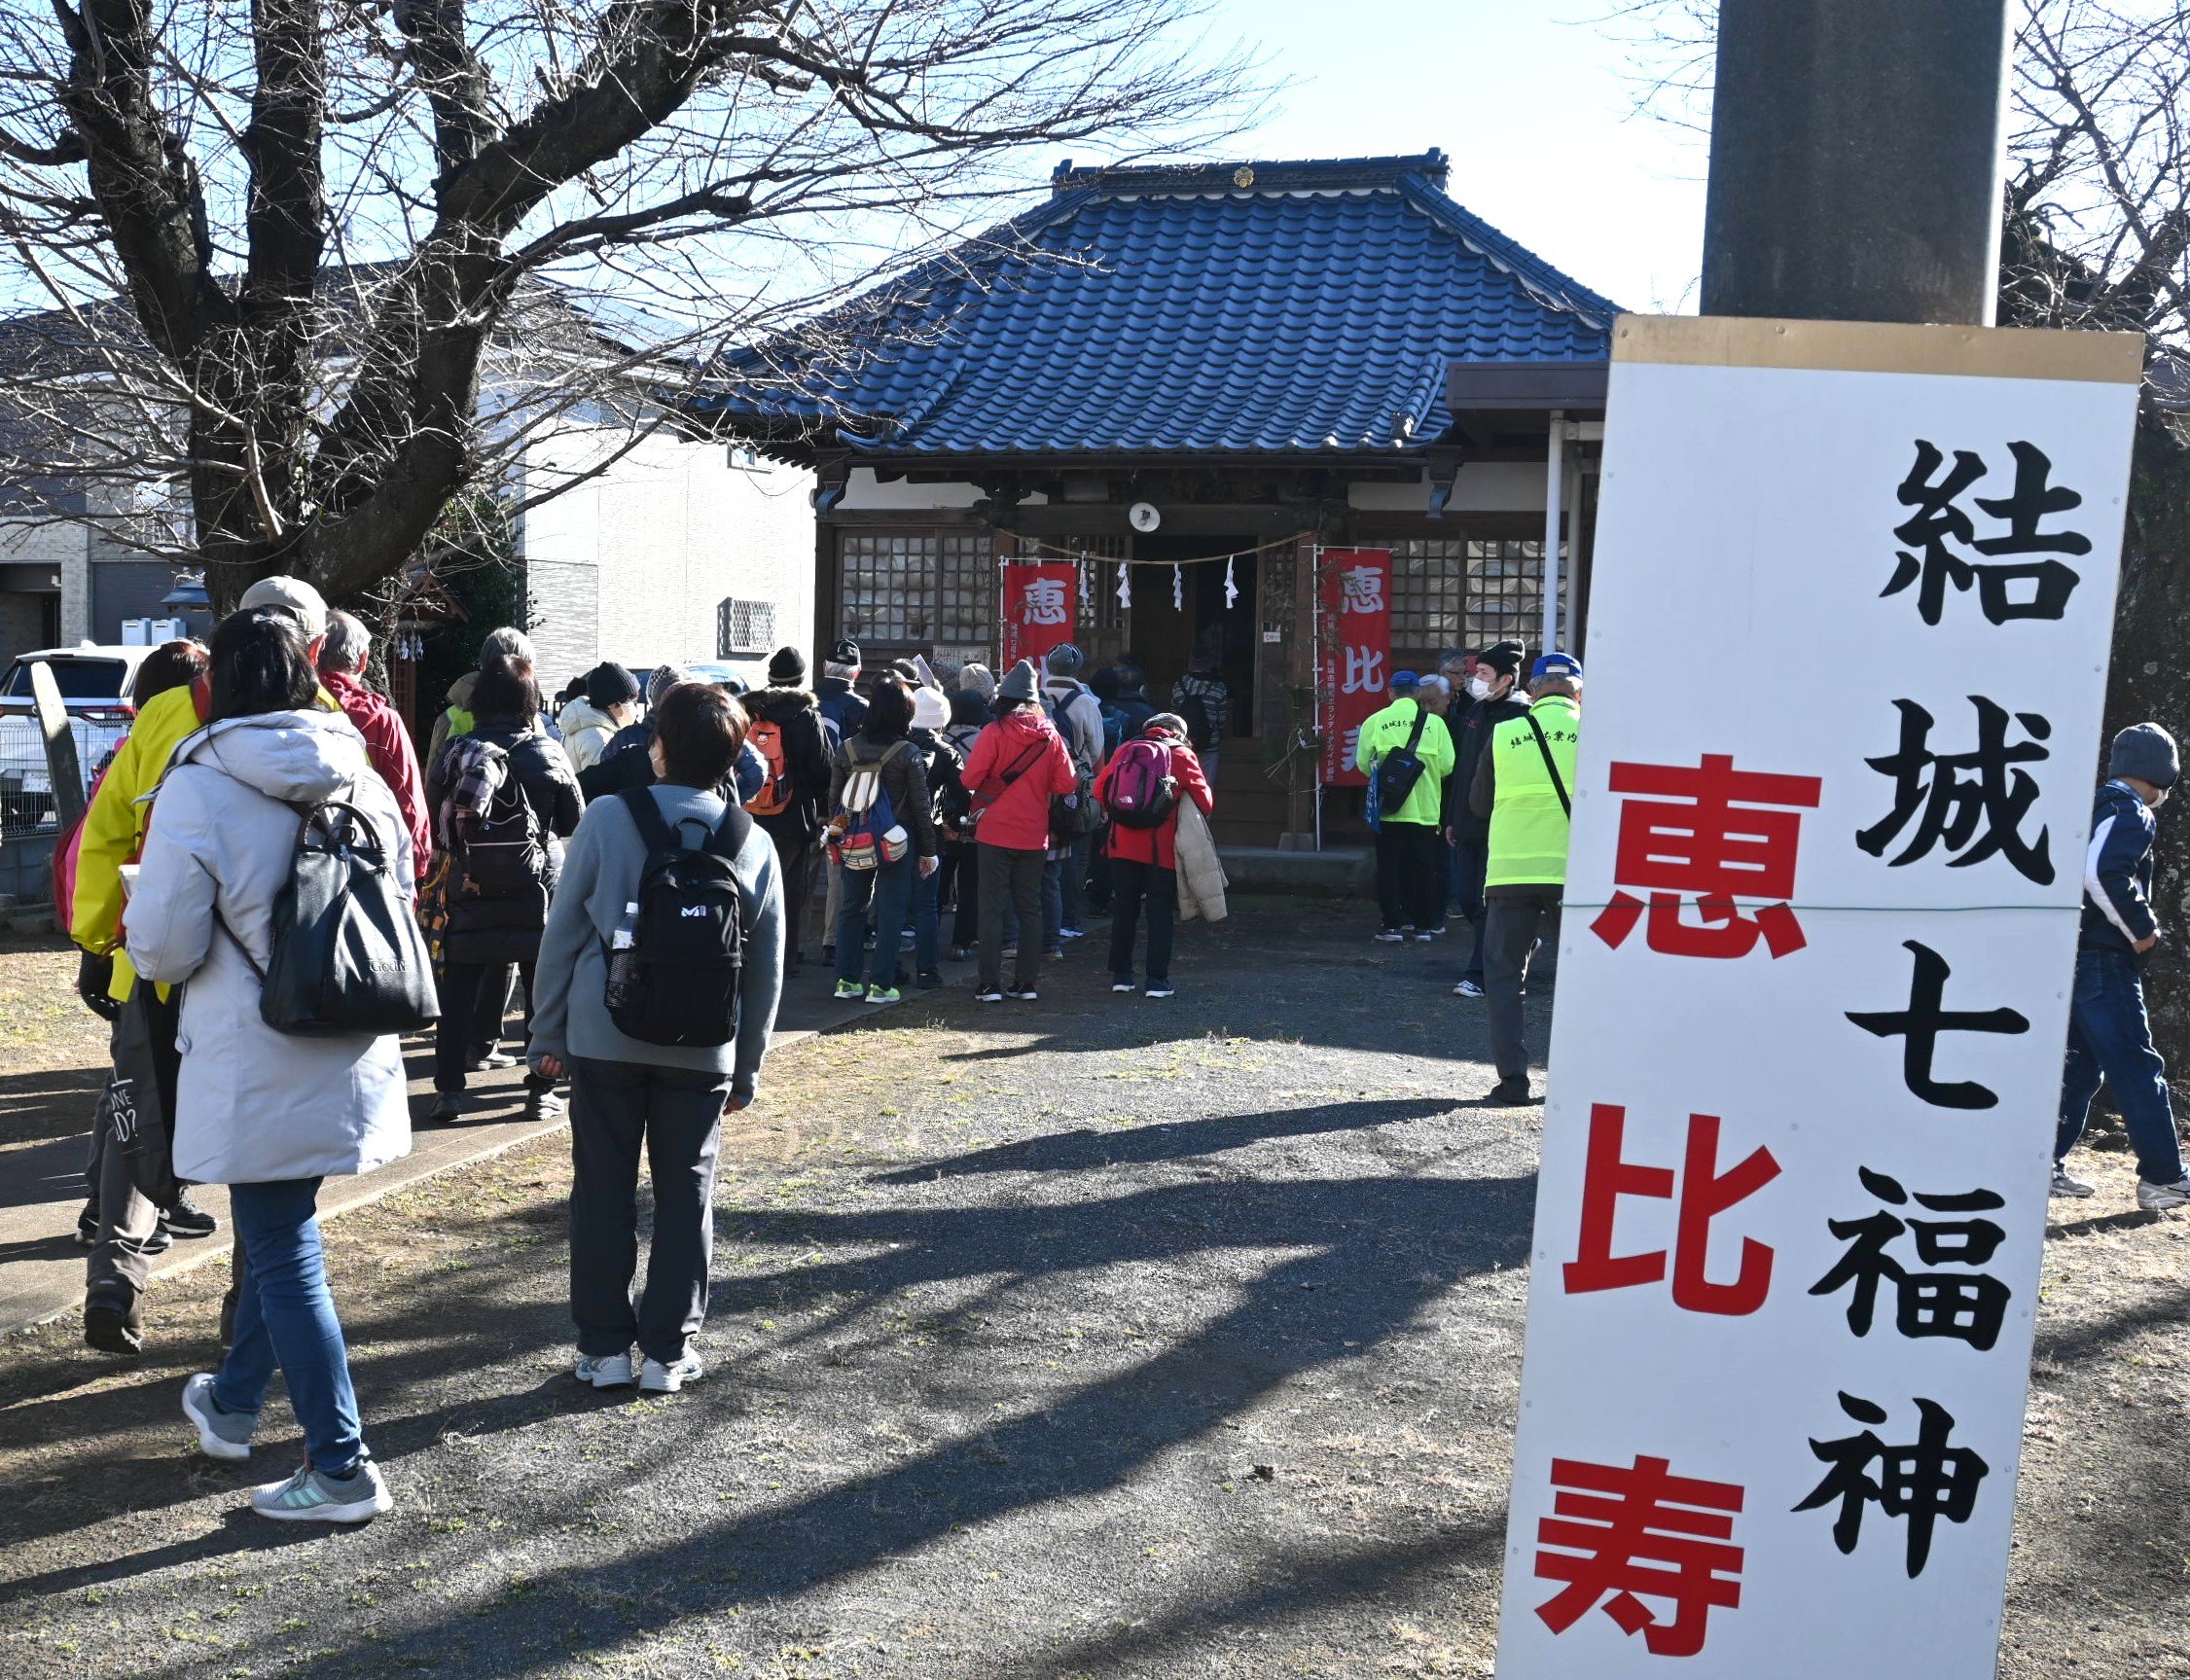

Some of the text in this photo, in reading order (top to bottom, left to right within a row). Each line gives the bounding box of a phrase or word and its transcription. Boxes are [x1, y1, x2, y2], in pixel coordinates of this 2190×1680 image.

[1534, 755, 1822, 1656] 恵比寿
[1792, 441, 2092, 1578] 結城七福神
